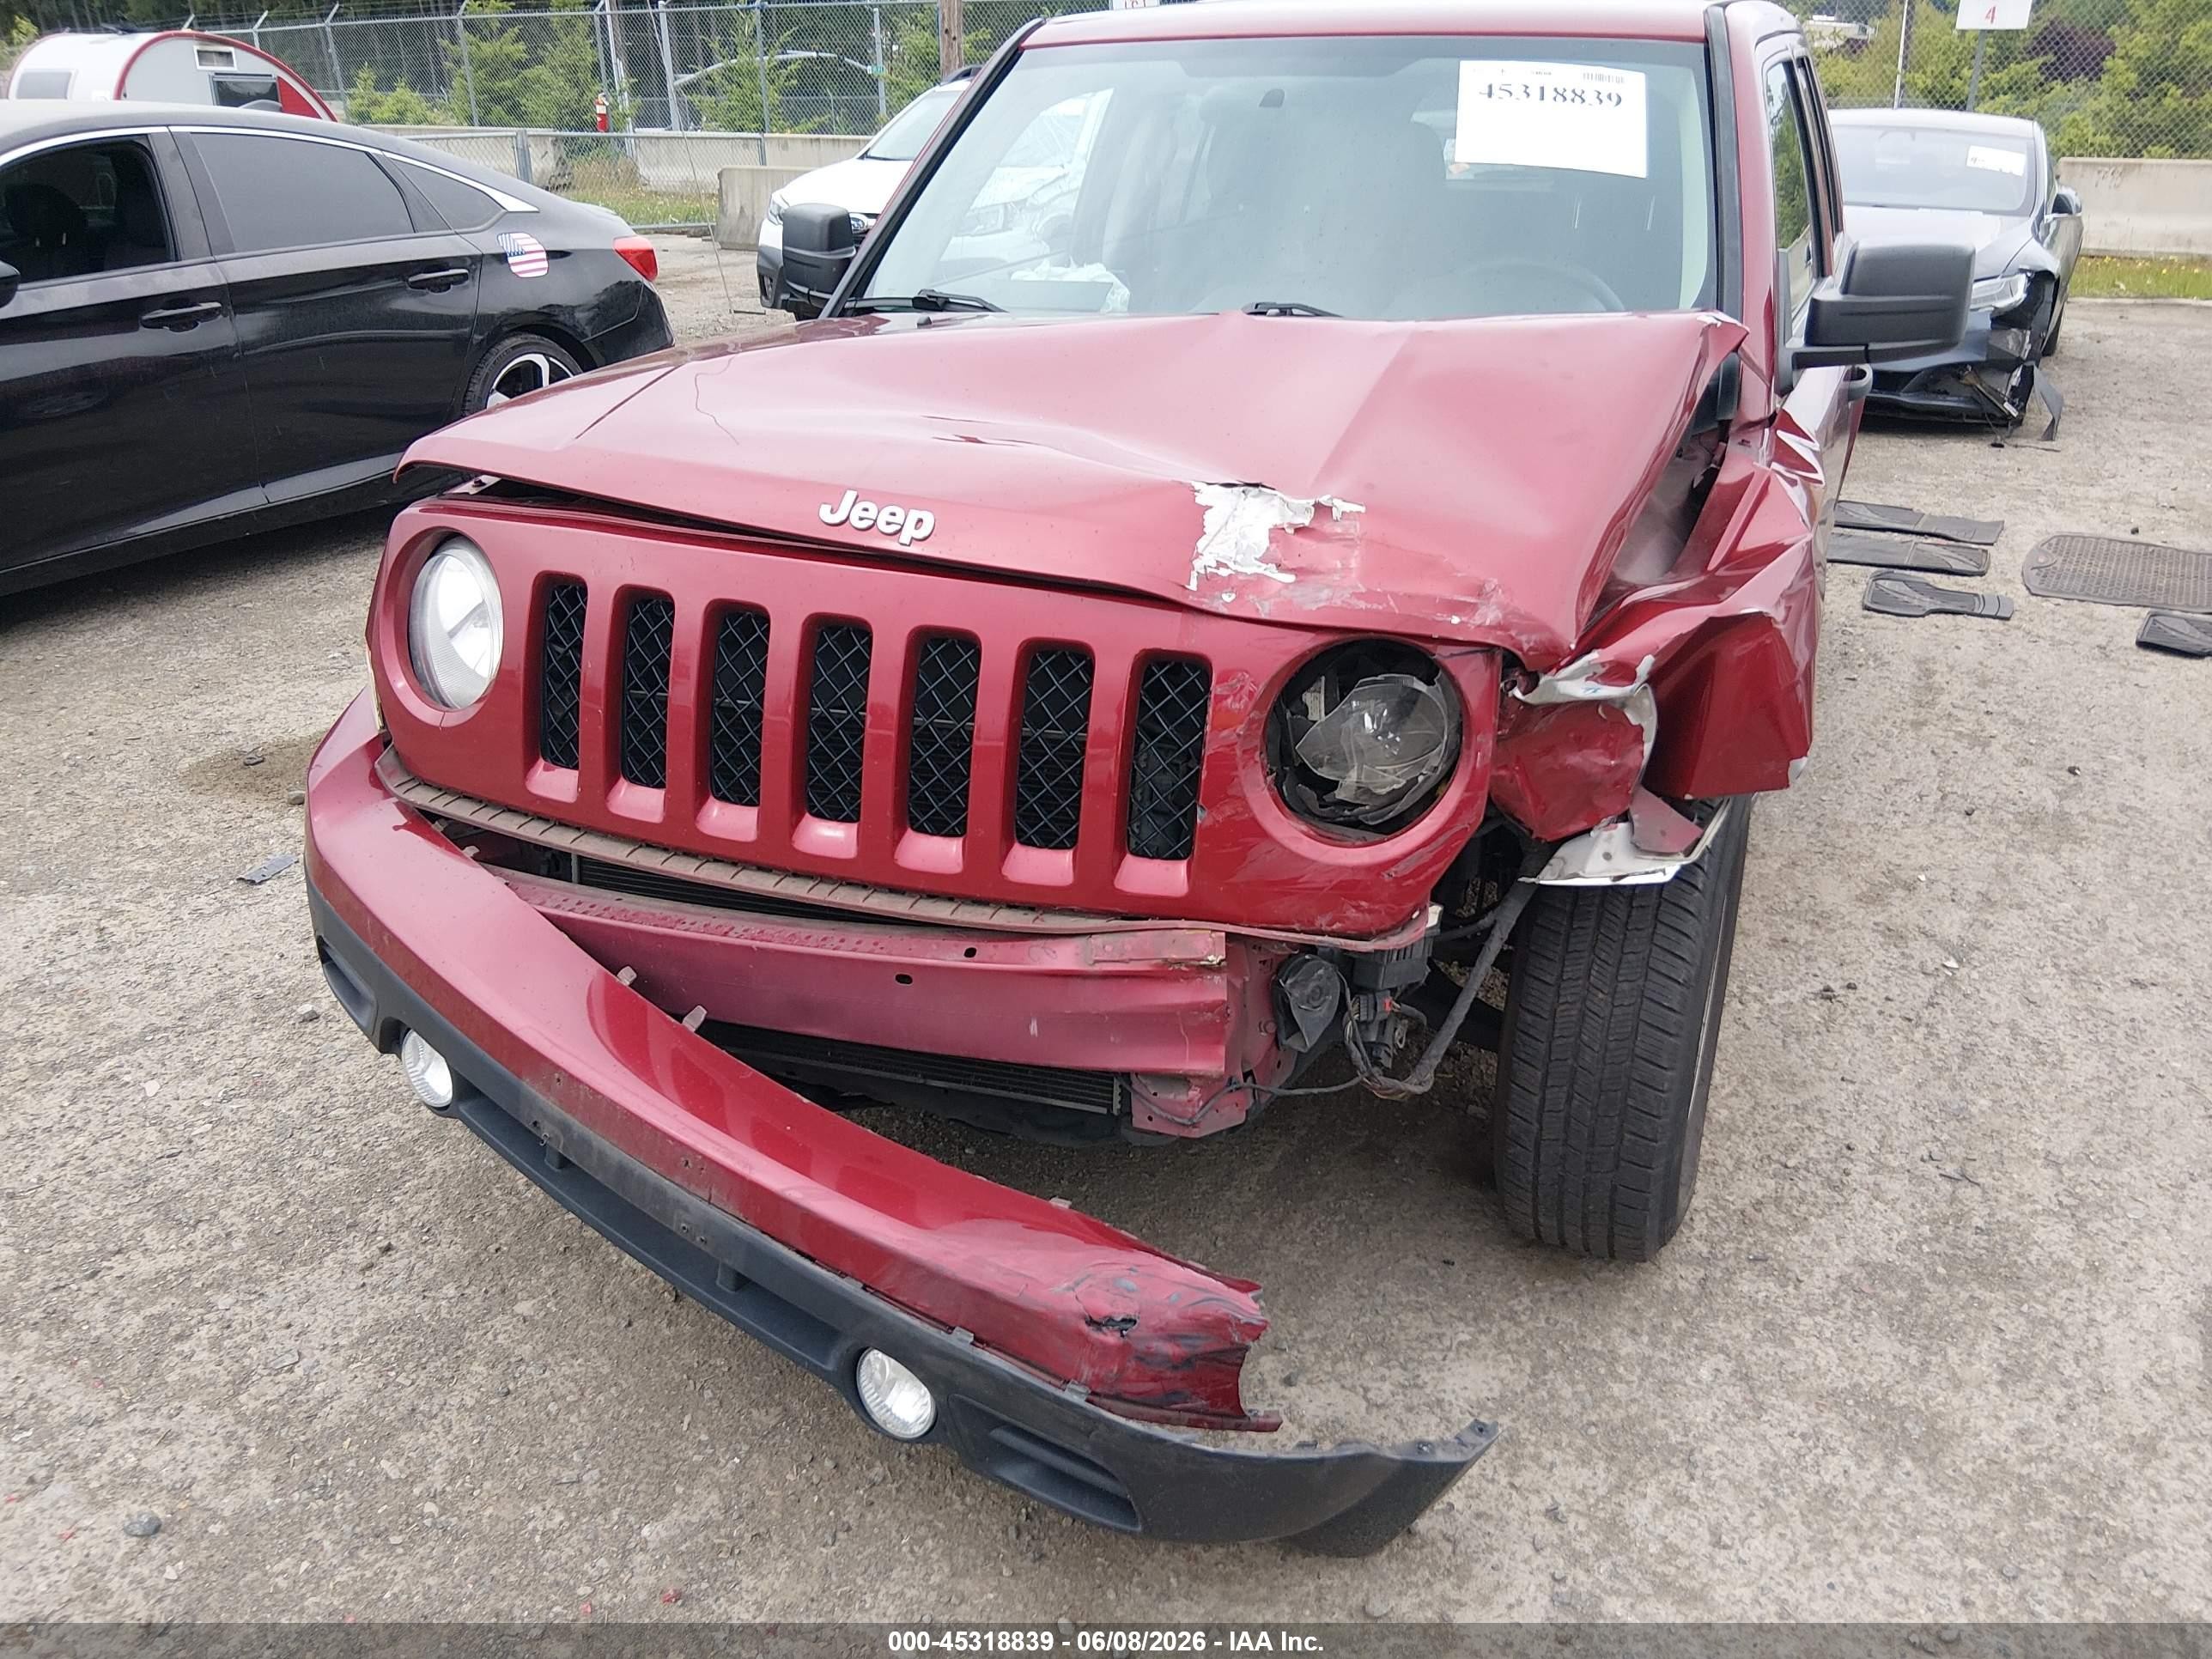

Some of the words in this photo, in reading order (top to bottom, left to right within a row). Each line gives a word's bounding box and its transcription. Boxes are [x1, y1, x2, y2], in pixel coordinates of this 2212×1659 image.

[1984, 6, 1996, 24] 4
[1480, 82, 1622, 107] 45318839
[818, 489, 936, 546] Jeep
